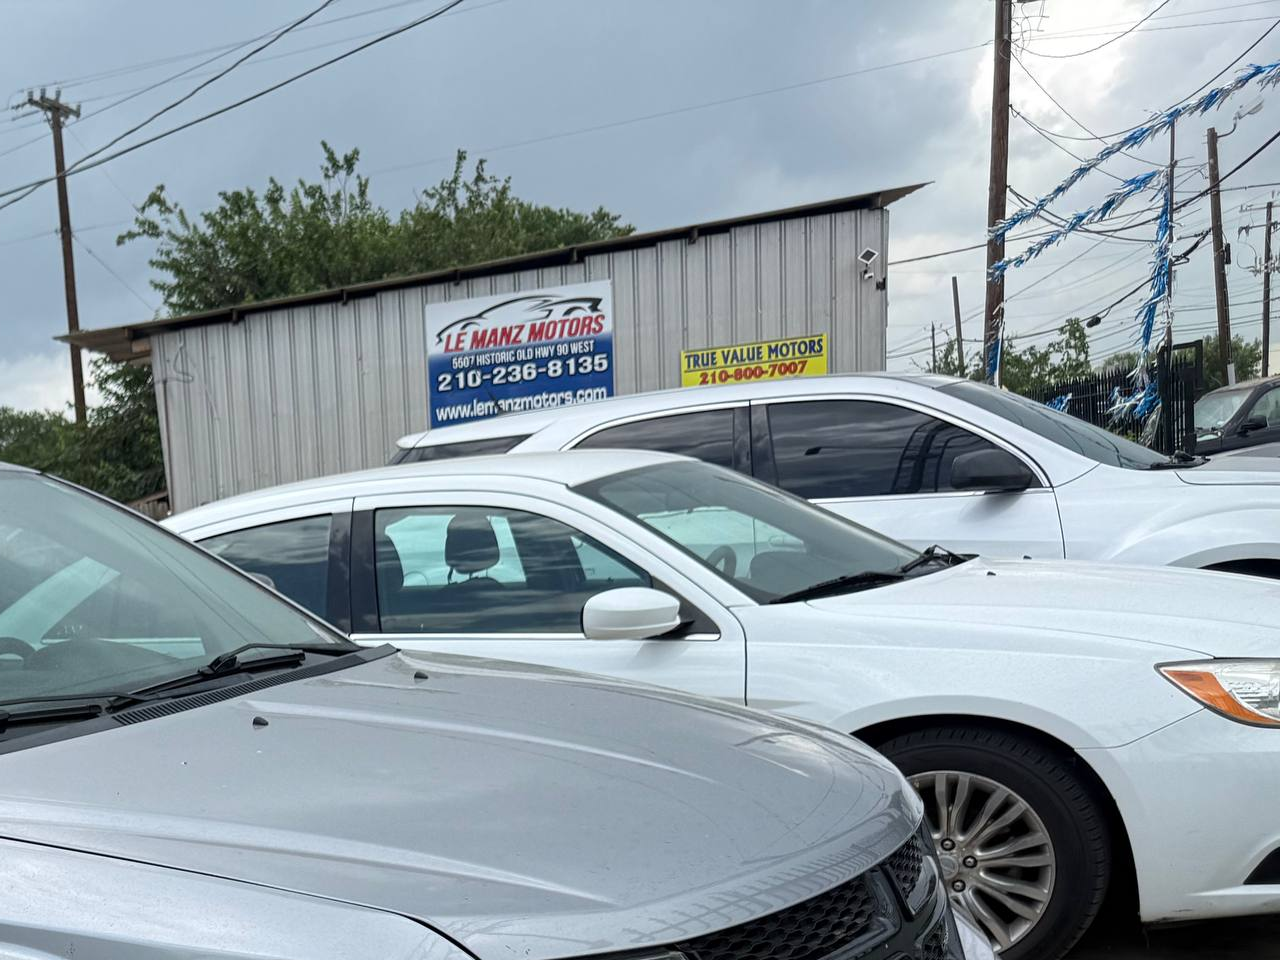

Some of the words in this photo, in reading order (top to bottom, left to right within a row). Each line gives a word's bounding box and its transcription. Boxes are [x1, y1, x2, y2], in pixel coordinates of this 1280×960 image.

[444, 332, 467, 353] LE
[470, 324, 525, 349] MANZ
[527, 314, 606, 343] MOTORS
[476, 351, 515, 366] HISTORIC
[516, 347, 533, 360] OLD
[535, 345, 555, 358] HWY
[556, 343, 568, 356] 90
[570, 340, 594, 354] WEST
[685, 352, 717, 369] TRUE
[721, 346, 763, 365] VALUE
[768, 338, 824, 359] MOTORS
[437, 353, 608, 392] 210-236-8135
[435, 387, 607, 422] www.lemanzmotors.com
